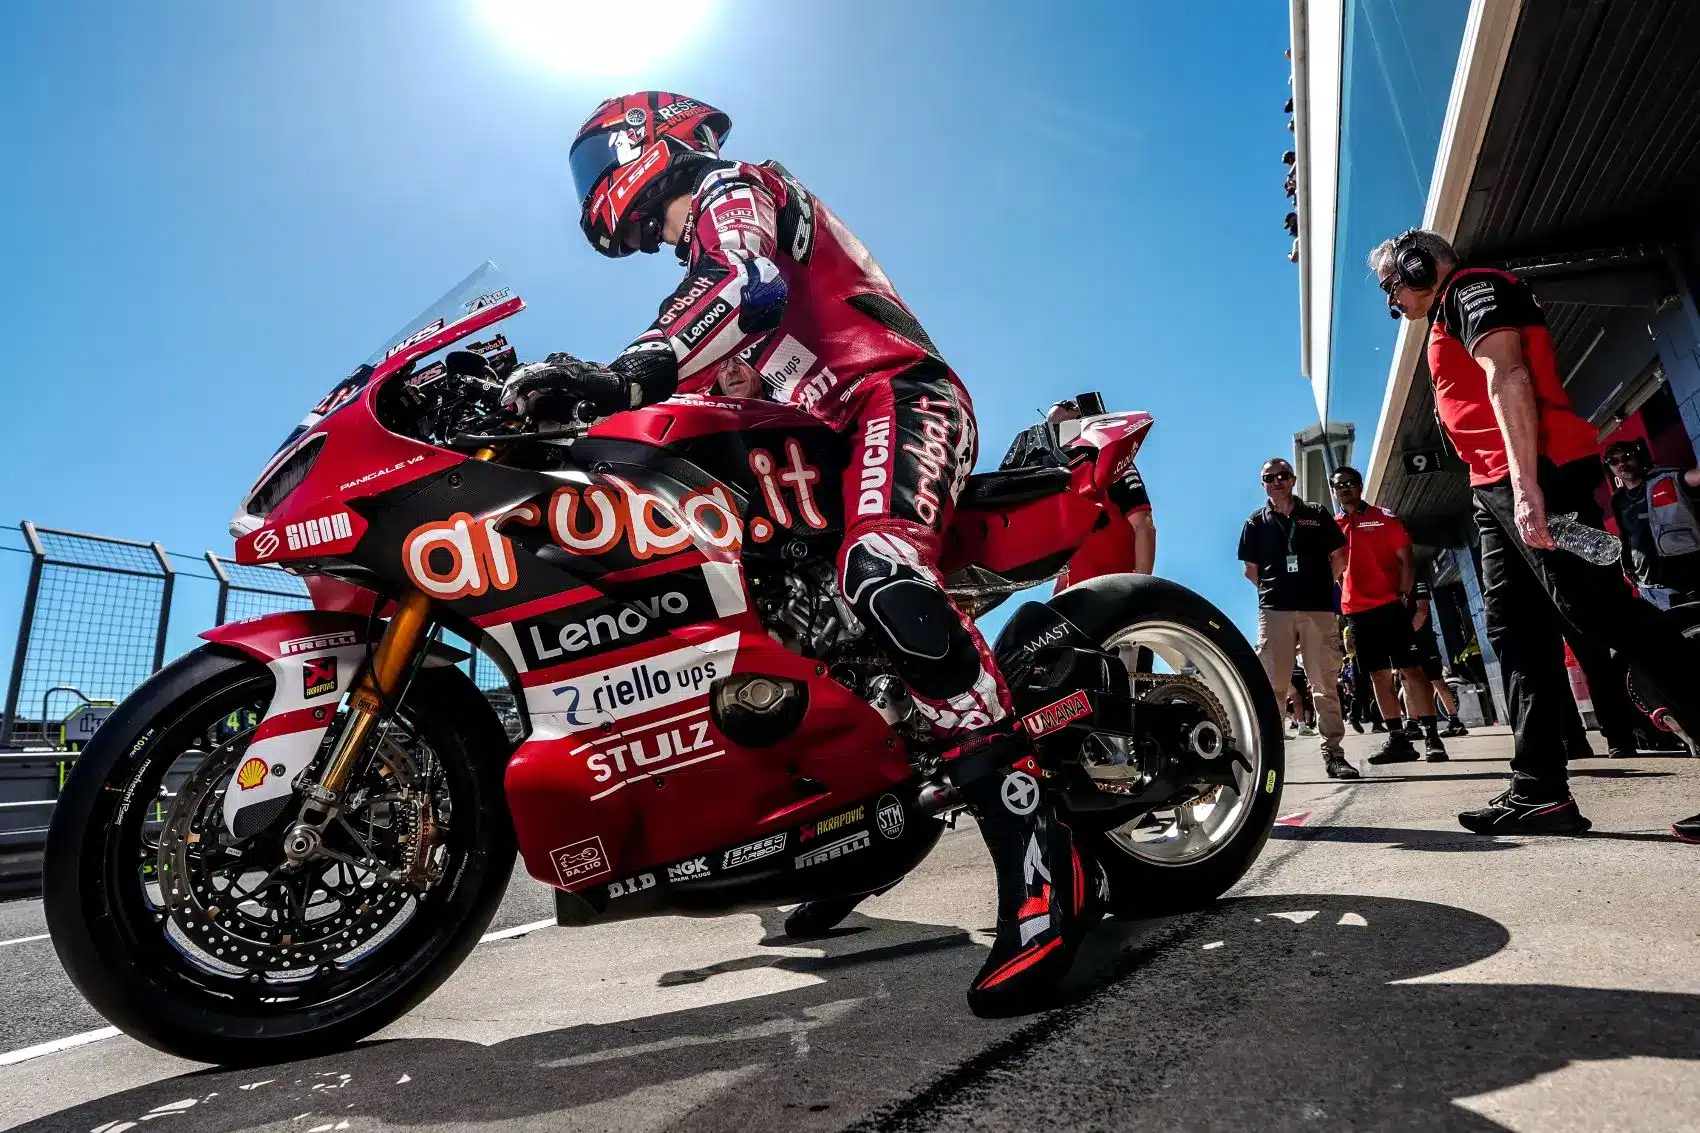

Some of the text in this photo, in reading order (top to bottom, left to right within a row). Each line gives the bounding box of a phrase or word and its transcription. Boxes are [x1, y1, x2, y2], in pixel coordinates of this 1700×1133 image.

[617, 149, 660, 199] LS2
[660, 276, 714, 324] aruba.it
[682, 303, 726, 344] Lenovo
[783, 355, 801, 374] ups
[340, 454, 425, 492] PANIGALE V4
[1413, 455, 1427, 471] 9
[402, 438, 828, 600] aruba.it
[279, 631, 357, 655] PIRELLI
[530, 591, 689, 661] Lenovo
[592, 661, 717, 714] riello ups
[1027, 696, 1087, 734] UMANA
[586, 720, 714, 783] STULZ
[123, 758, 152, 804] marchesini
[879, 805, 902, 829] STM
[731, 842, 783, 864] CARBON
[732, 835, 783, 857] SPEED
[795, 830, 870, 869] PIRELLI
[667, 856, 709, 877] NGK
[691, 871, 712, 879] PLUGS
[608, 873, 656, 899] D.I.D
